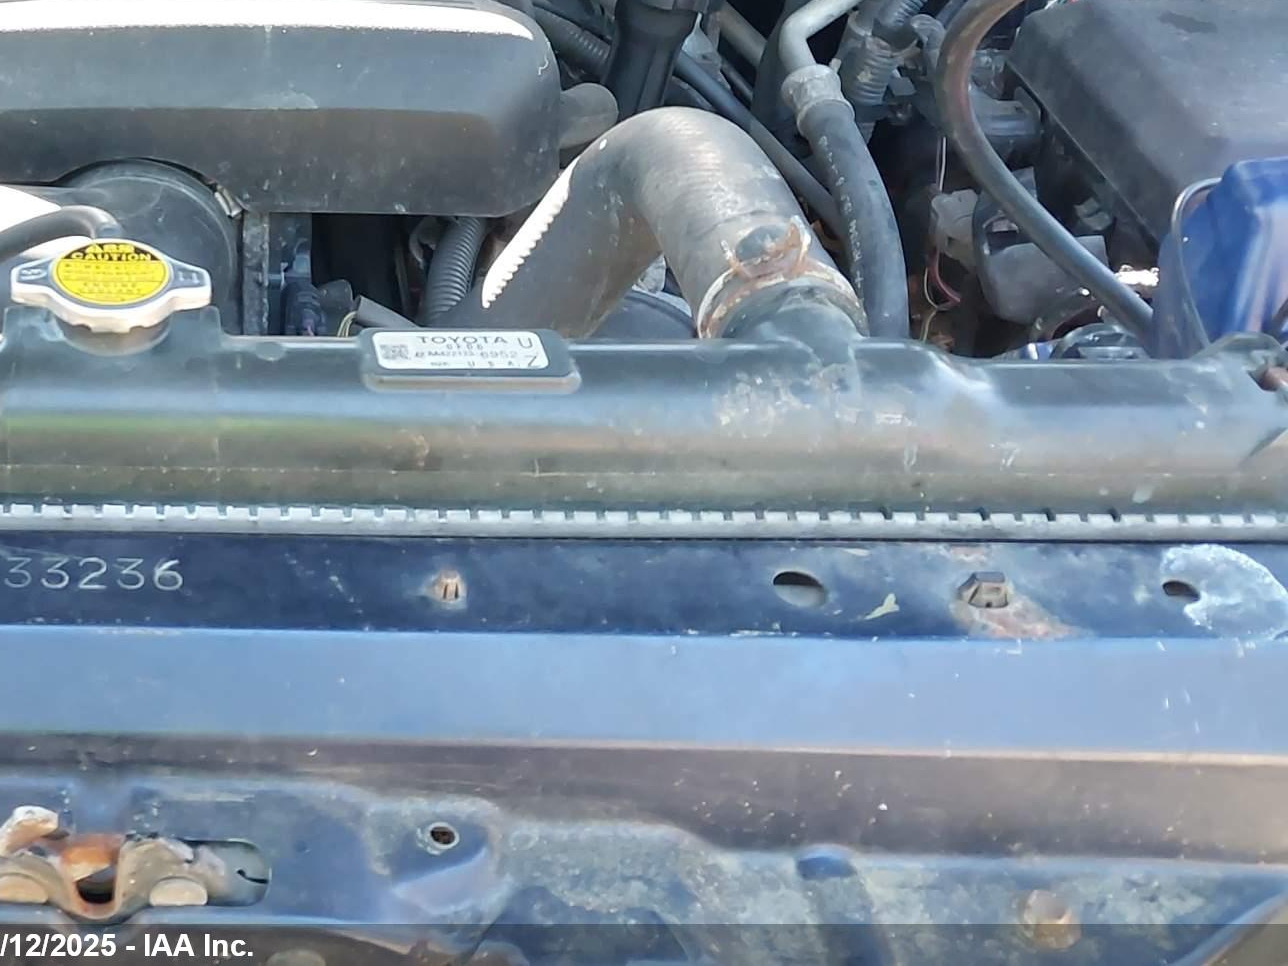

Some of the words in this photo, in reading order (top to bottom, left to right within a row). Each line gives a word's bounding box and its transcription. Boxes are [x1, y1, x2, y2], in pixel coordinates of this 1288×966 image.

[70, 251, 152, 262] CAUTION
[416, 336, 509, 344] TOYOTA
[517, 337, 534, 349] U
[3, 556, 183, 591] 33236
